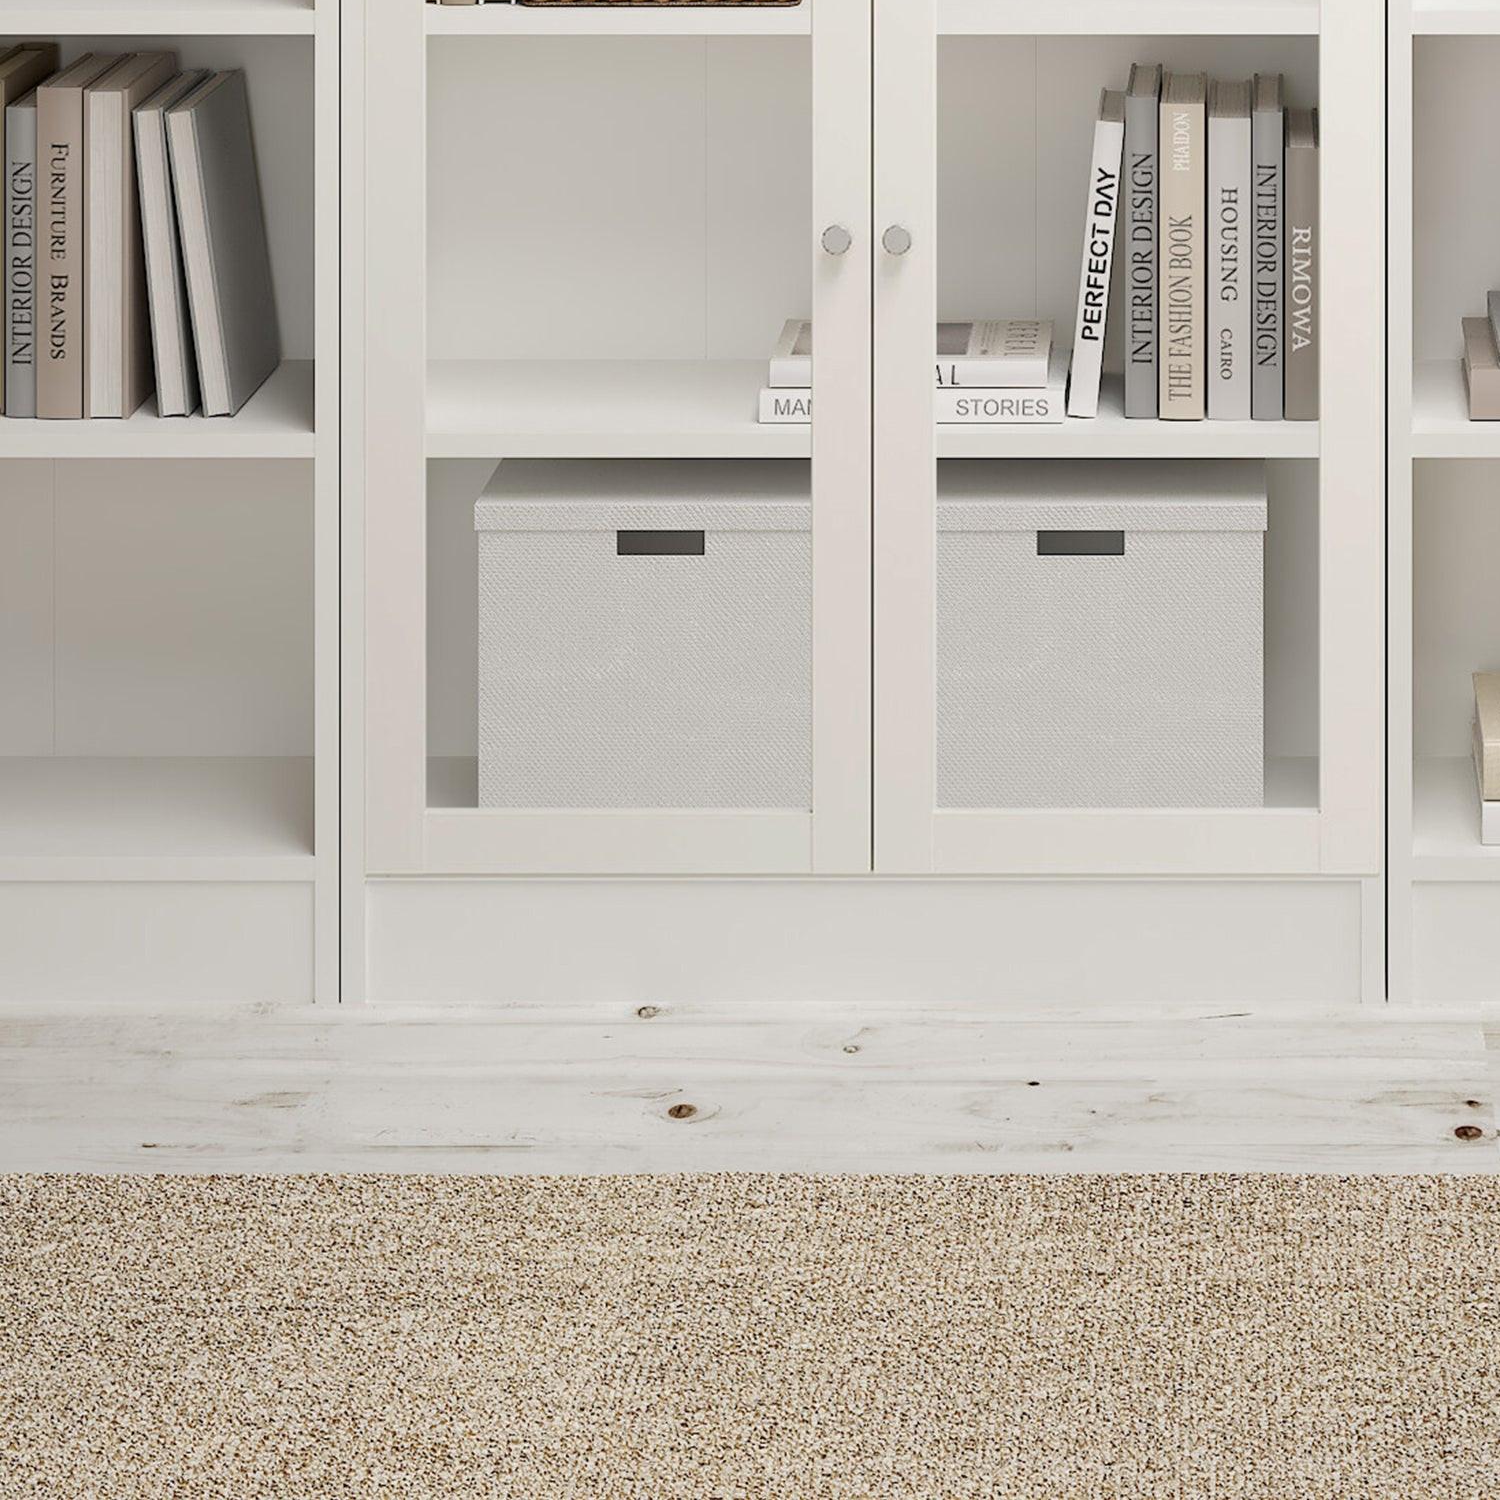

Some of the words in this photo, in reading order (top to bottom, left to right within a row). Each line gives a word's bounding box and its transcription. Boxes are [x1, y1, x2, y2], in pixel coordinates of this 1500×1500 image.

[1172, 112, 1191, 172] PHAIDON
[12, 161, 33, 250] DESIGN
[50, 143, 70, 260] FURNITURE
[1094, 167, 1116, 217] DAY
[1132, 153, 1154, 242] DESIGN
[1256, 164, 1278, 274] INTERIOR
[1081, 223, 1111, 341] PERFECT
[1168, 215, 1193, 269] BOOK
[1220, 187, 1239, 302] HOUSING
[12, 257, 33, 365] INTERIOR
[50, 275, 69, 361] BRANDS
[1132, 250, 1154, 364] INTERIOR
[1168, 275, 1193, 360] FASHION
[1256, 281, 1278, 367] DESIGN
[1291, 226, 1312, 353] RIMOWA
[1168, 364, 1193, 402] THE
[1220, 328, 1233, 381] CAIRO
[956, 399, 1049, 417] STORIES
